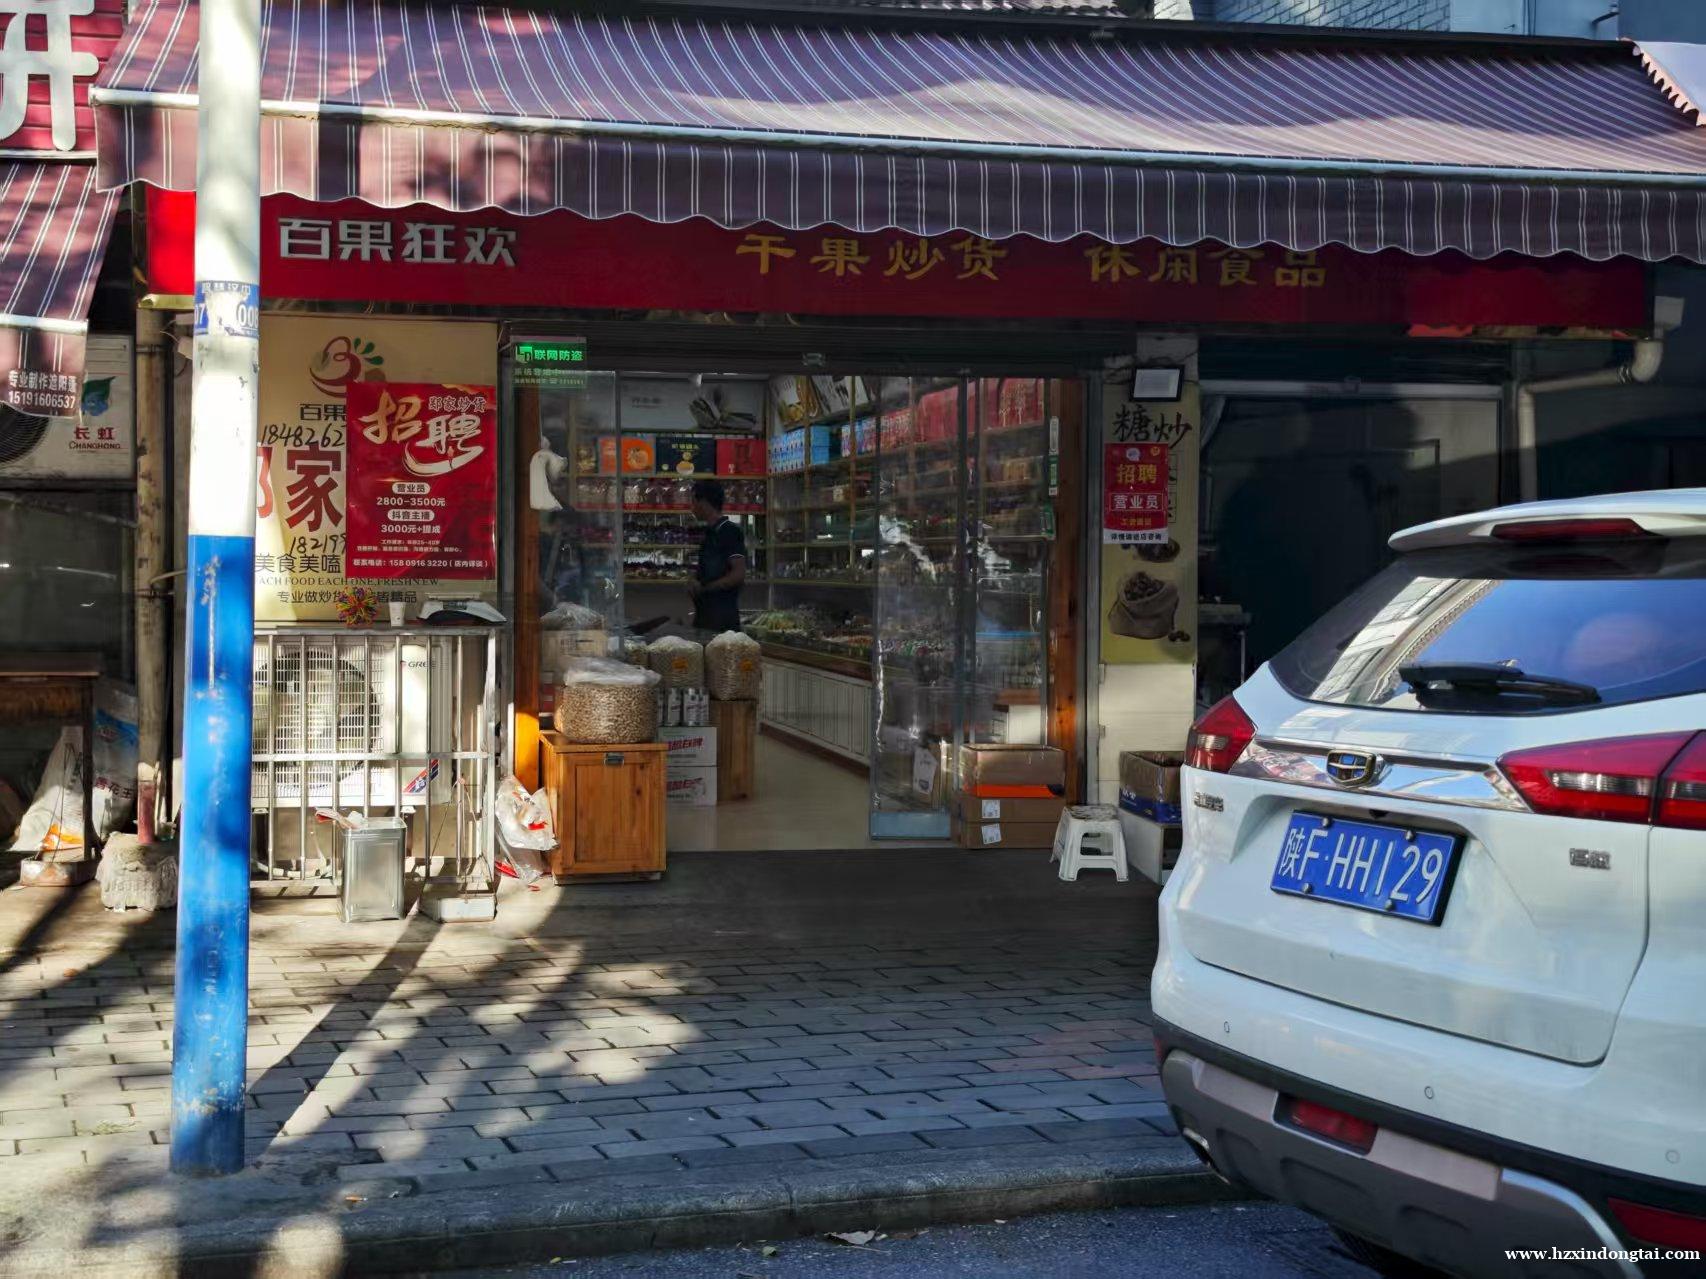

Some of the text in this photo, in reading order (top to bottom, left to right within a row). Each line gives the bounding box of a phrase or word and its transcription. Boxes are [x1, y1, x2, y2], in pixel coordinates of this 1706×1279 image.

[278, 218, 516, 267] 百果狂欢
[736, 234, 1008, 280] 干果炒货
[1085, 247, 1327, 287] 休闲食品
[534, 349, 584, 361] 联网防盗
[9, 391, 76, 409] 15191606537
[300, 404, 346, 421] 百果
[75, 427, 114, 440] 长虹
[261, 423, 346, 447] 1848262
[1113, 403, 1193, 449] 糖炒
[1117, 464, 1158, 485] 招聘
[1113, 495, 1159, 510] 营业员
[257, 577, 282, 586] ACH
[1279, 828, 1443, 905] 陕F·HH129
